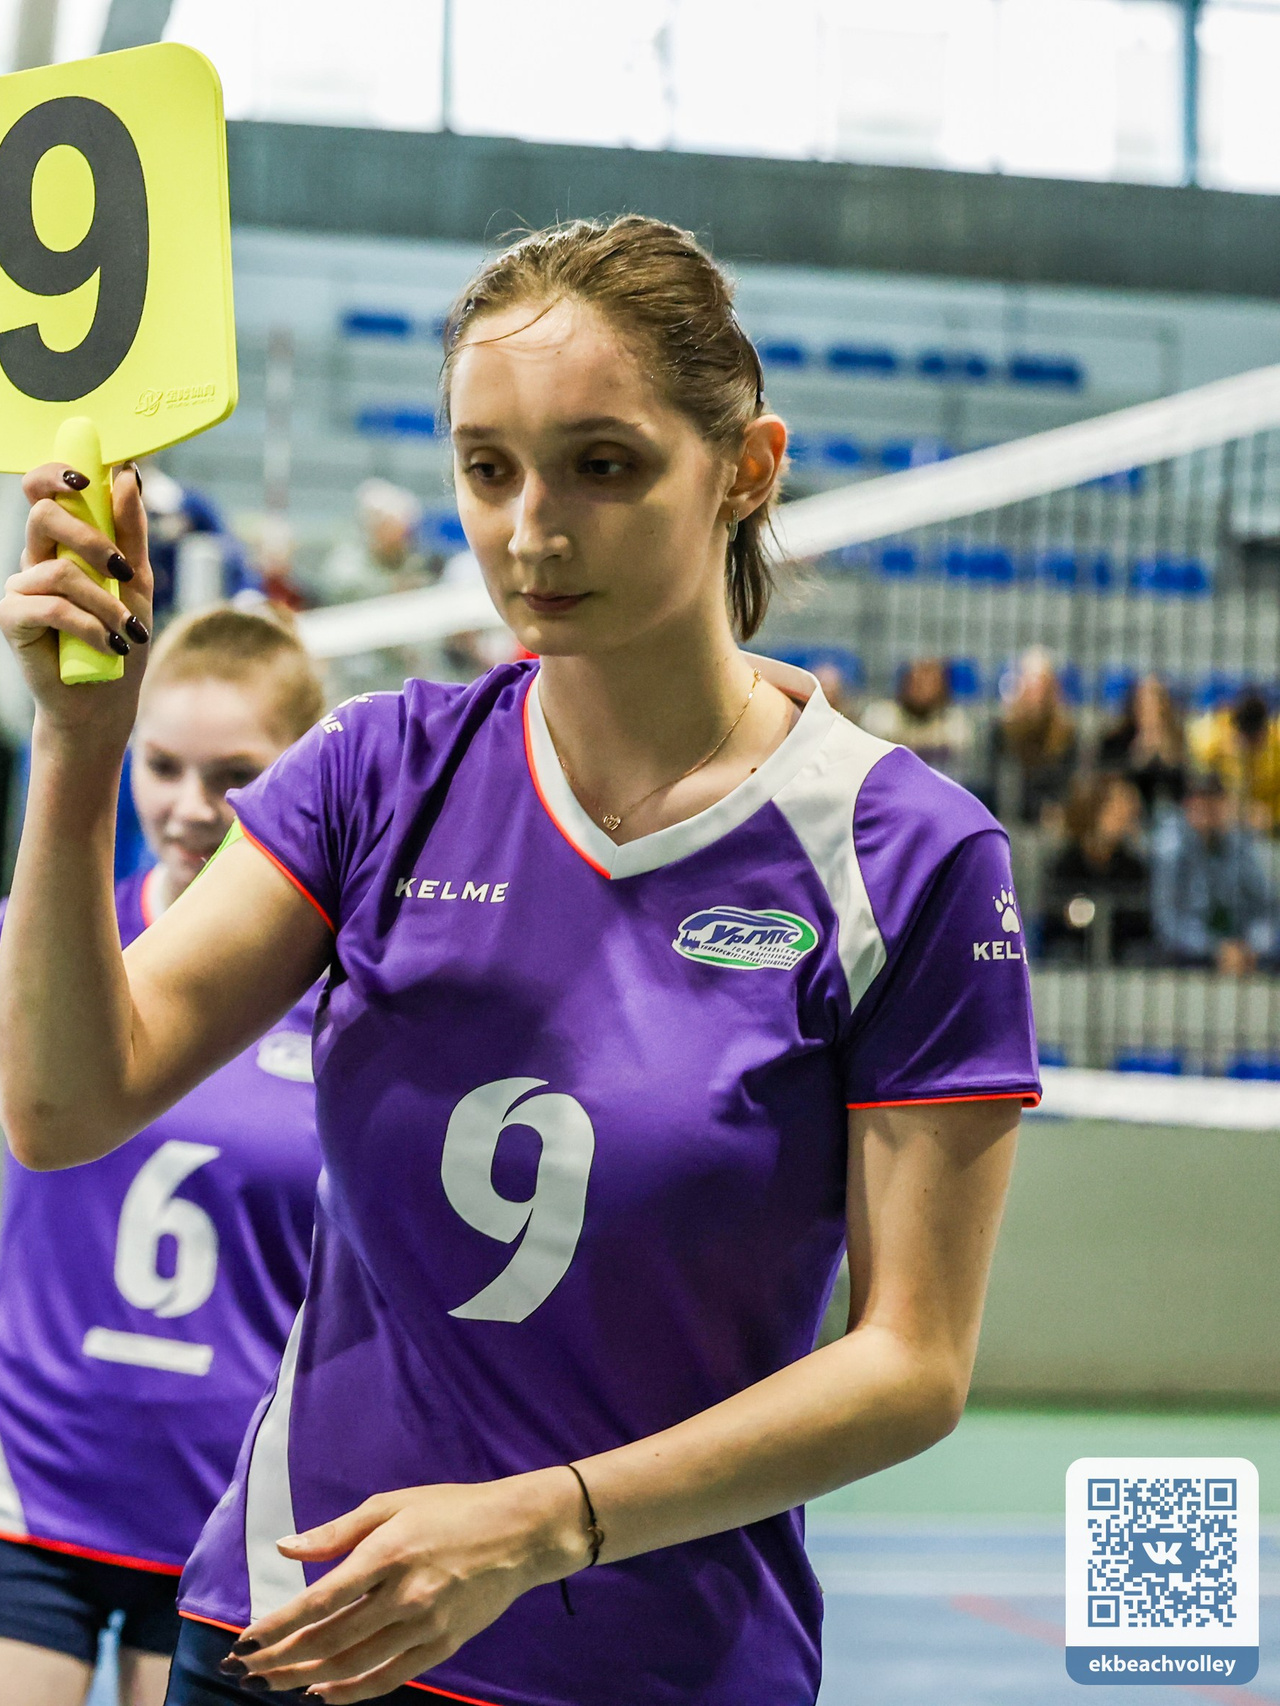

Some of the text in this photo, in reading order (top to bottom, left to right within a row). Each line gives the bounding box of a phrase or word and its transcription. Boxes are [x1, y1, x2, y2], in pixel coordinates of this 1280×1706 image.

[394, 877, 509, 903] KELME
[973, 941, 1028, 965] KEL
[113, 1139, 220, 1318] 6
[441, 1077, 596, 1324] 9
